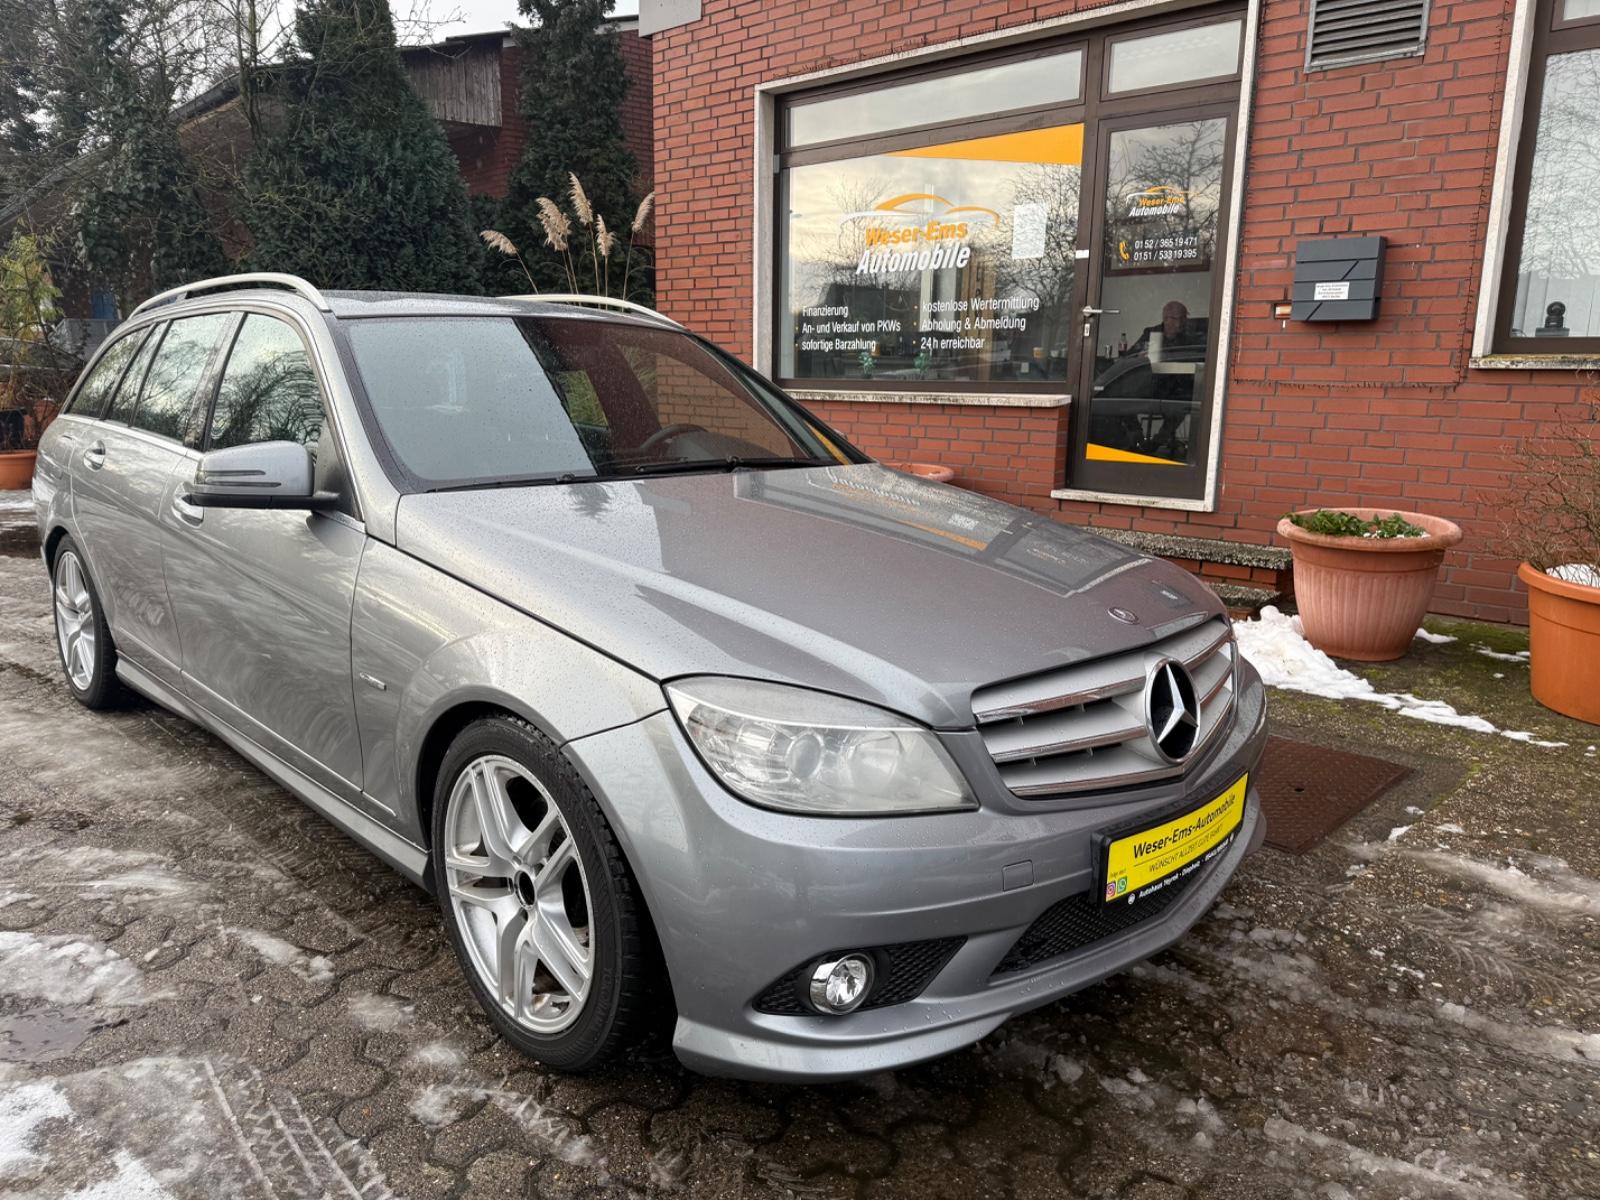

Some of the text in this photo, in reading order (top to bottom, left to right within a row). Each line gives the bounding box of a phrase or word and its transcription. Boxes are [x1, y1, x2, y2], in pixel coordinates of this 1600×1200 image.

[1128, 204, 1180, 217] Automobile
[865, 219, 968, 246] Weser-Ems
[1134, 240, 1153, 249] 0152
[856, 242, 971, 274] Automobile
[1133, 251, 1152, 261] 0151
[802, 305, 849, 318] Finanzierung
[922, 296, 1040, 312] kostenlose Wertermittlung
[802, 319, 901, 334] An- und Verkauf von PKWs
[921, 316, 1027, 333] Abholung & Abmeldung
[801, 338, 876, 353] sofortige Barzahlung
[940, 335, 985, 349] erreichbar
[1133, 793, 1237, 859] Weser-Ems-Automobile
